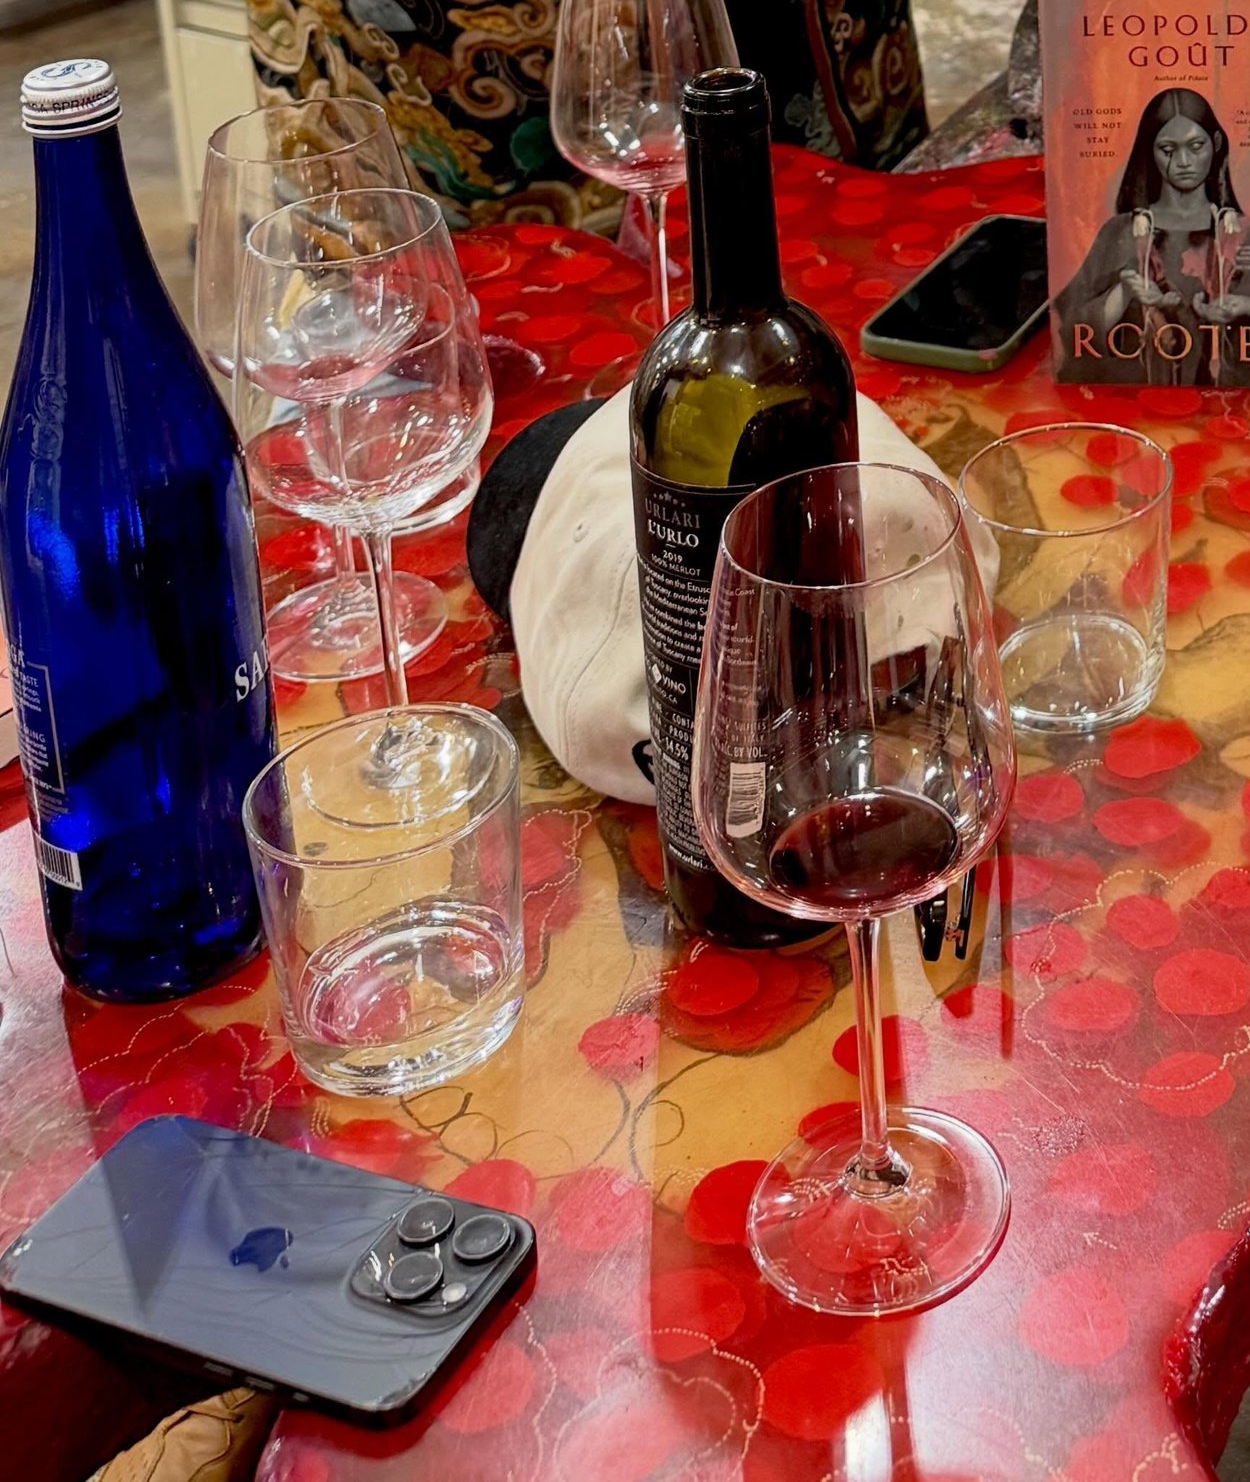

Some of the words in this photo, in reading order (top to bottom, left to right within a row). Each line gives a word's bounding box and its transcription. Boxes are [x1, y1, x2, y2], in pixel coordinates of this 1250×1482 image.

[1128, 42, 1235, 67] GOÛT
[1153, 74, 1177, 82] Author
[1072, 108, 1093, 116] OLD
[1095, 107, 1122, 116] GODS
[1074, 122, 1098, 130] WILL
[1086, 136, 1110, 144] STAY
[644, 497, 701, 529] URLARI
[662, 549, 683, 563] 2019
[669, 562, 701, 577] MERLOT
[665, 578, 674, 586] on
[674, 579, 686, 590] the
[687, 581, 711, 594] Etrusc
[672, 591, 709, 606] overlookin
[684, 619, 696, 630] the
[683, 631, 698, 641] and
[662, 674, 687, 695] VINO
[665, 736, 689, 761] 14.5%
[733, 746, 745, 758] BY
[746, 746, 768, 759] VOL.
